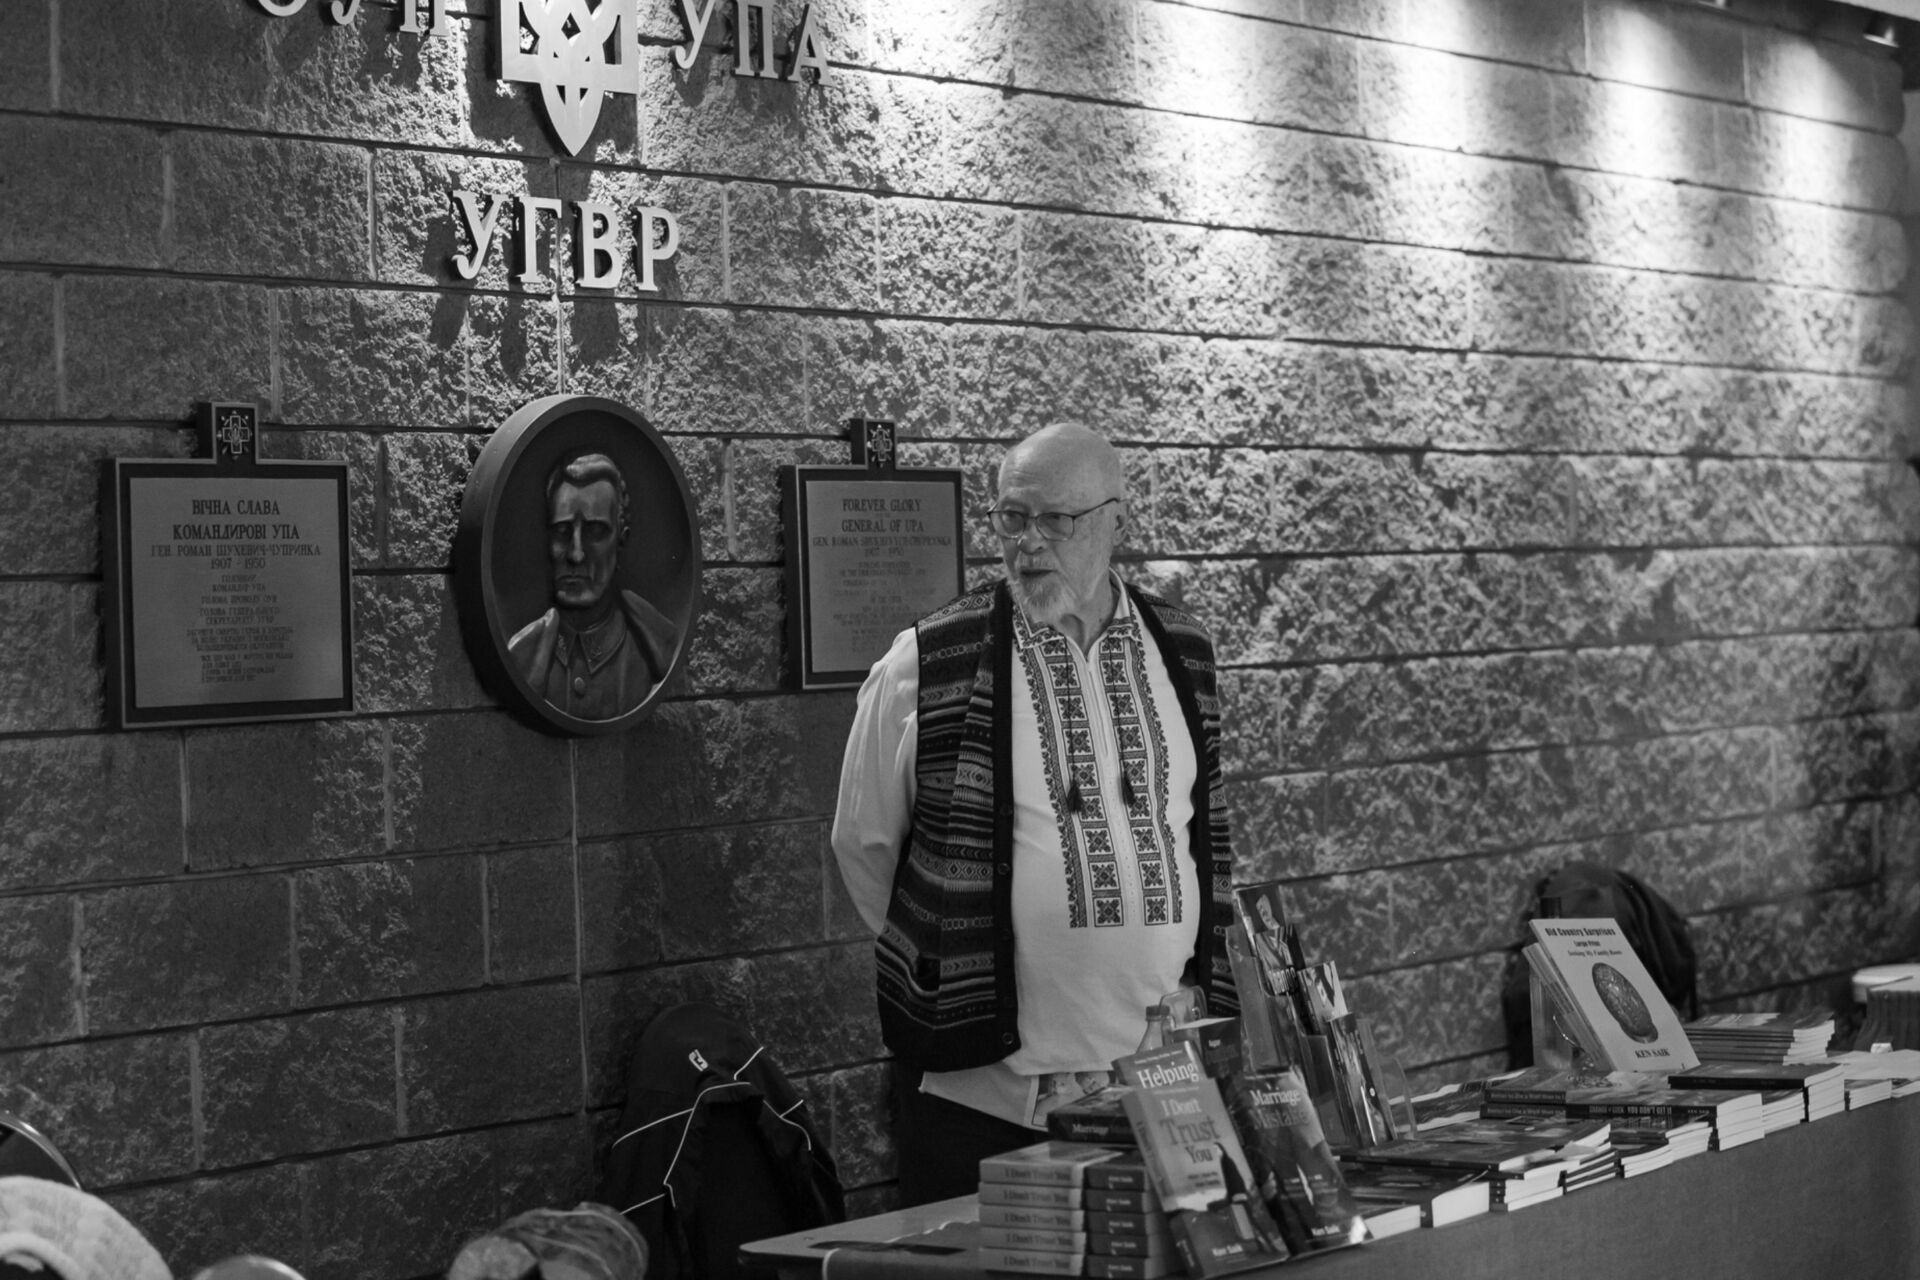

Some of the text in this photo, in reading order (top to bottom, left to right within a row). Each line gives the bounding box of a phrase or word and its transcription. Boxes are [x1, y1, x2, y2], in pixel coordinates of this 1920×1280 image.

[675, 0, 832, 87] УПА
[452, 189, 680, 291] УГВР
[192, 499, 281, 515] ВІЧНА СЛАВА
[842, 498, 921, 512] FOREVER GLORY
[172, 524, 300, 540] КОМАНДИРОВІ УПА
[841, 519, 925, 533] GENERAL OF UPA
[177, 544, 212, 557] РОМАН
[211, 557, 233, 569] 1907
[244, 557, 267, 569] 1950
[1557, 928, 1584, 937] Country
[1583, 928, 1616, 937] Surprises
[1635, 1049, 1652, 1059] KEN
[1136, 1061, 1200, 1090] Helping
[1249, 1086, 1301, 1107] Marriage
[1159, 1115, 1221, 1145] Trust
[1185, 1145, 1214, 1164] You
